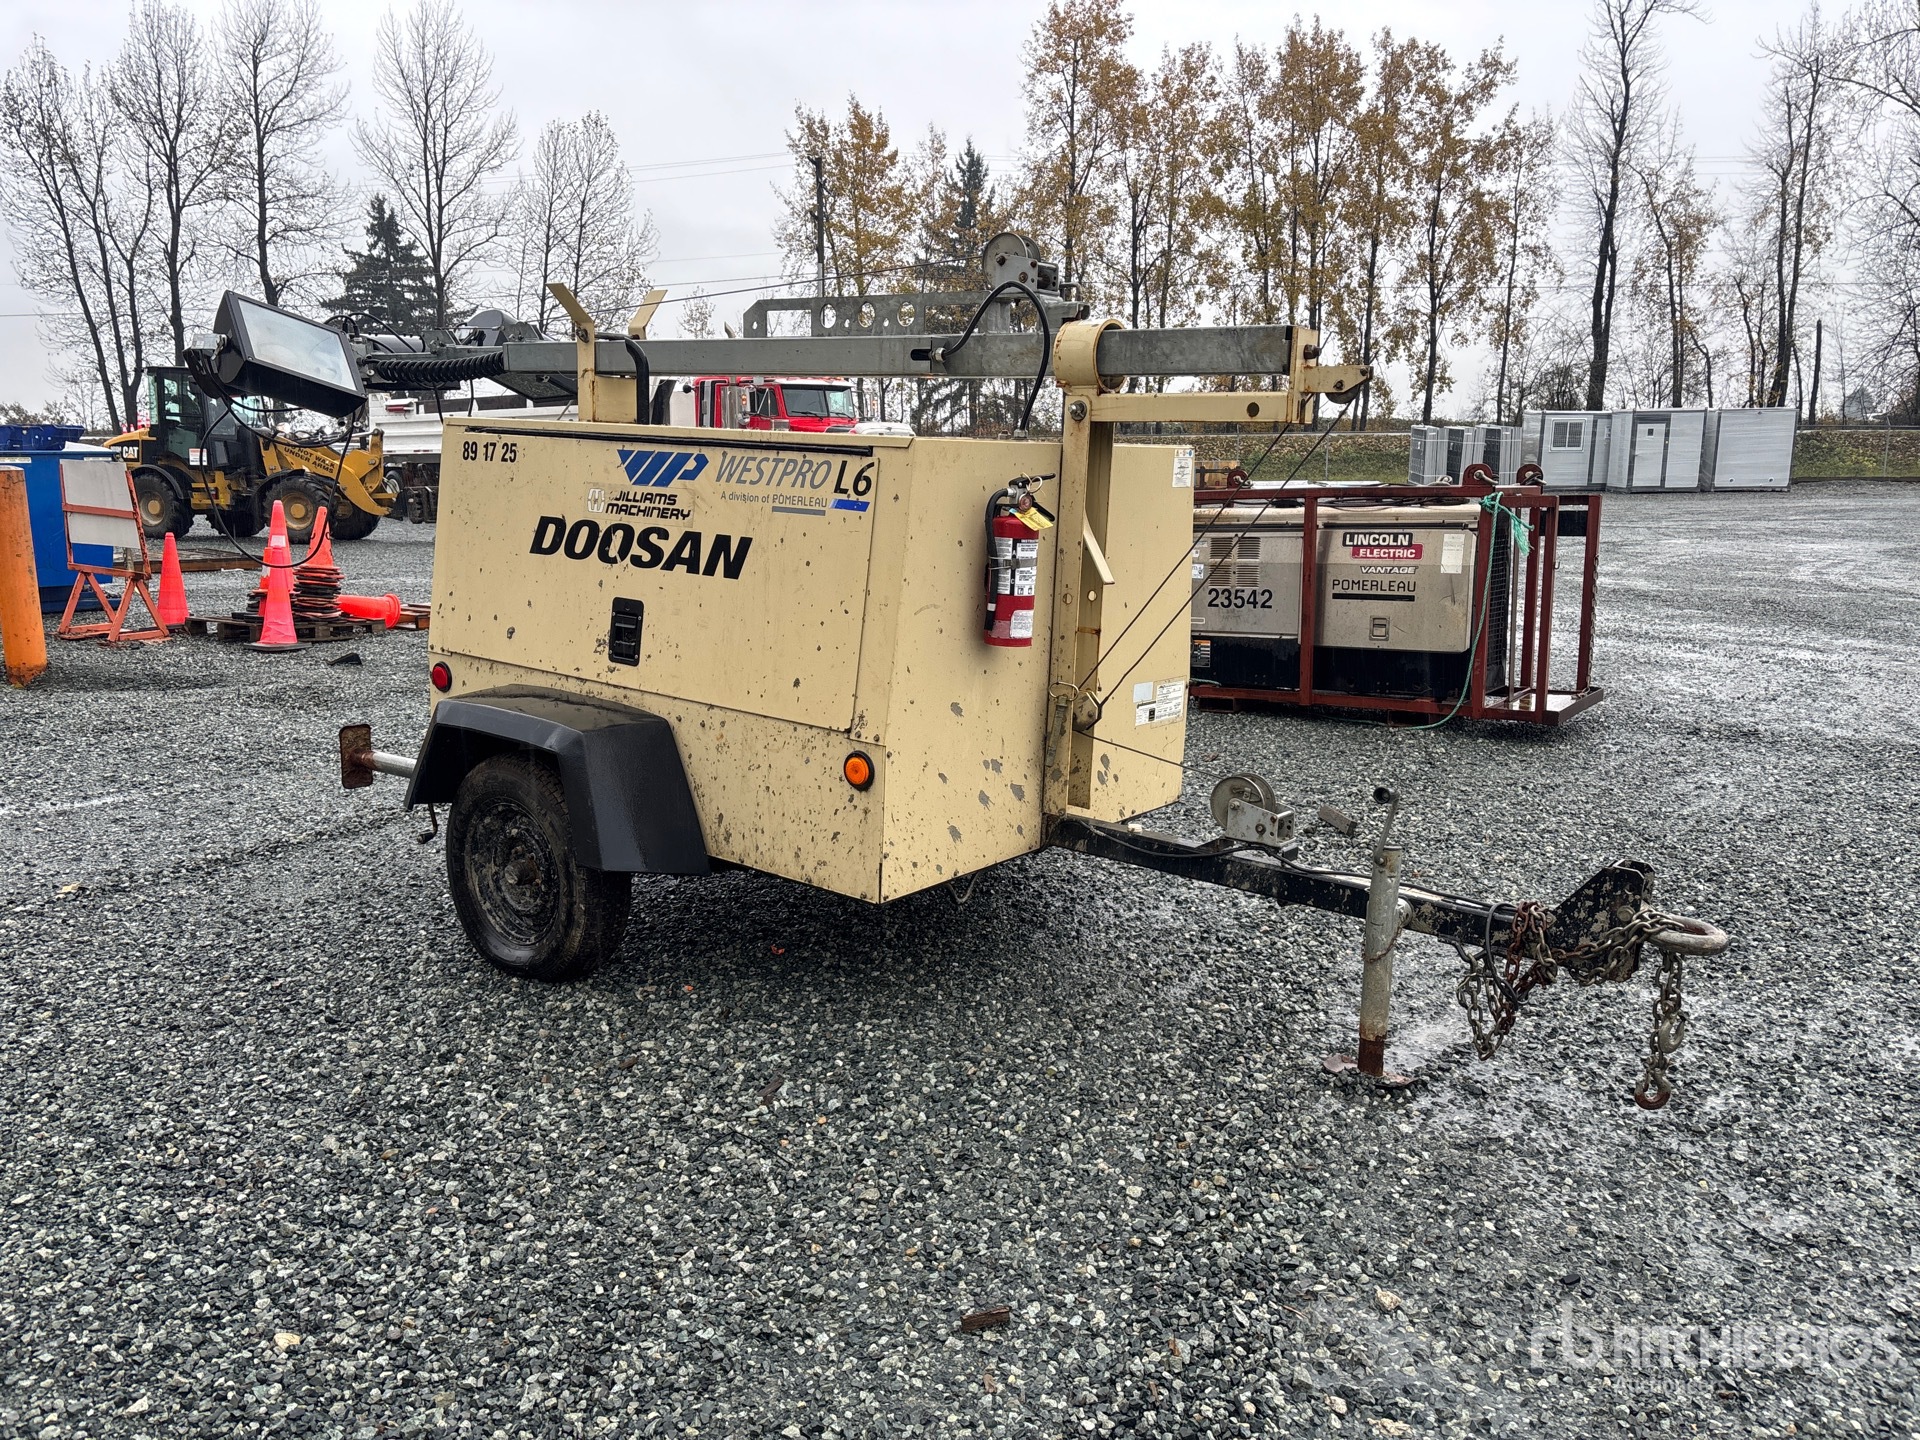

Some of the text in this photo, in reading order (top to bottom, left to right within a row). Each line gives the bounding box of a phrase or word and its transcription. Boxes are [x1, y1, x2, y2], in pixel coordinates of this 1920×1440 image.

[122, 445, 139, 459] CAT
[284, 446, 334, 473] UNDER ARMS
[298, 447, 314, 458] NOT
[463, 441, 517, 463] 89 17 25
[715, 453, 832, 490] WESTPRO
[833, 461, 875, 496] L6
[720, 491, 828, 508] A division of POMERLEAU
[605, 502, 691, 520] MACHINERY
[529, 515, 753, 580] DOOSAN
[1345, 534, 1410, 546] LINCOLN
[1359, 548, 1416, 558] ELECTRIC
[1360, 566, 1416, 574] VANTAGE
[1332, 579, 1416, 592] POMERLEAU
[1207, 588, 1273, 609] 23542
